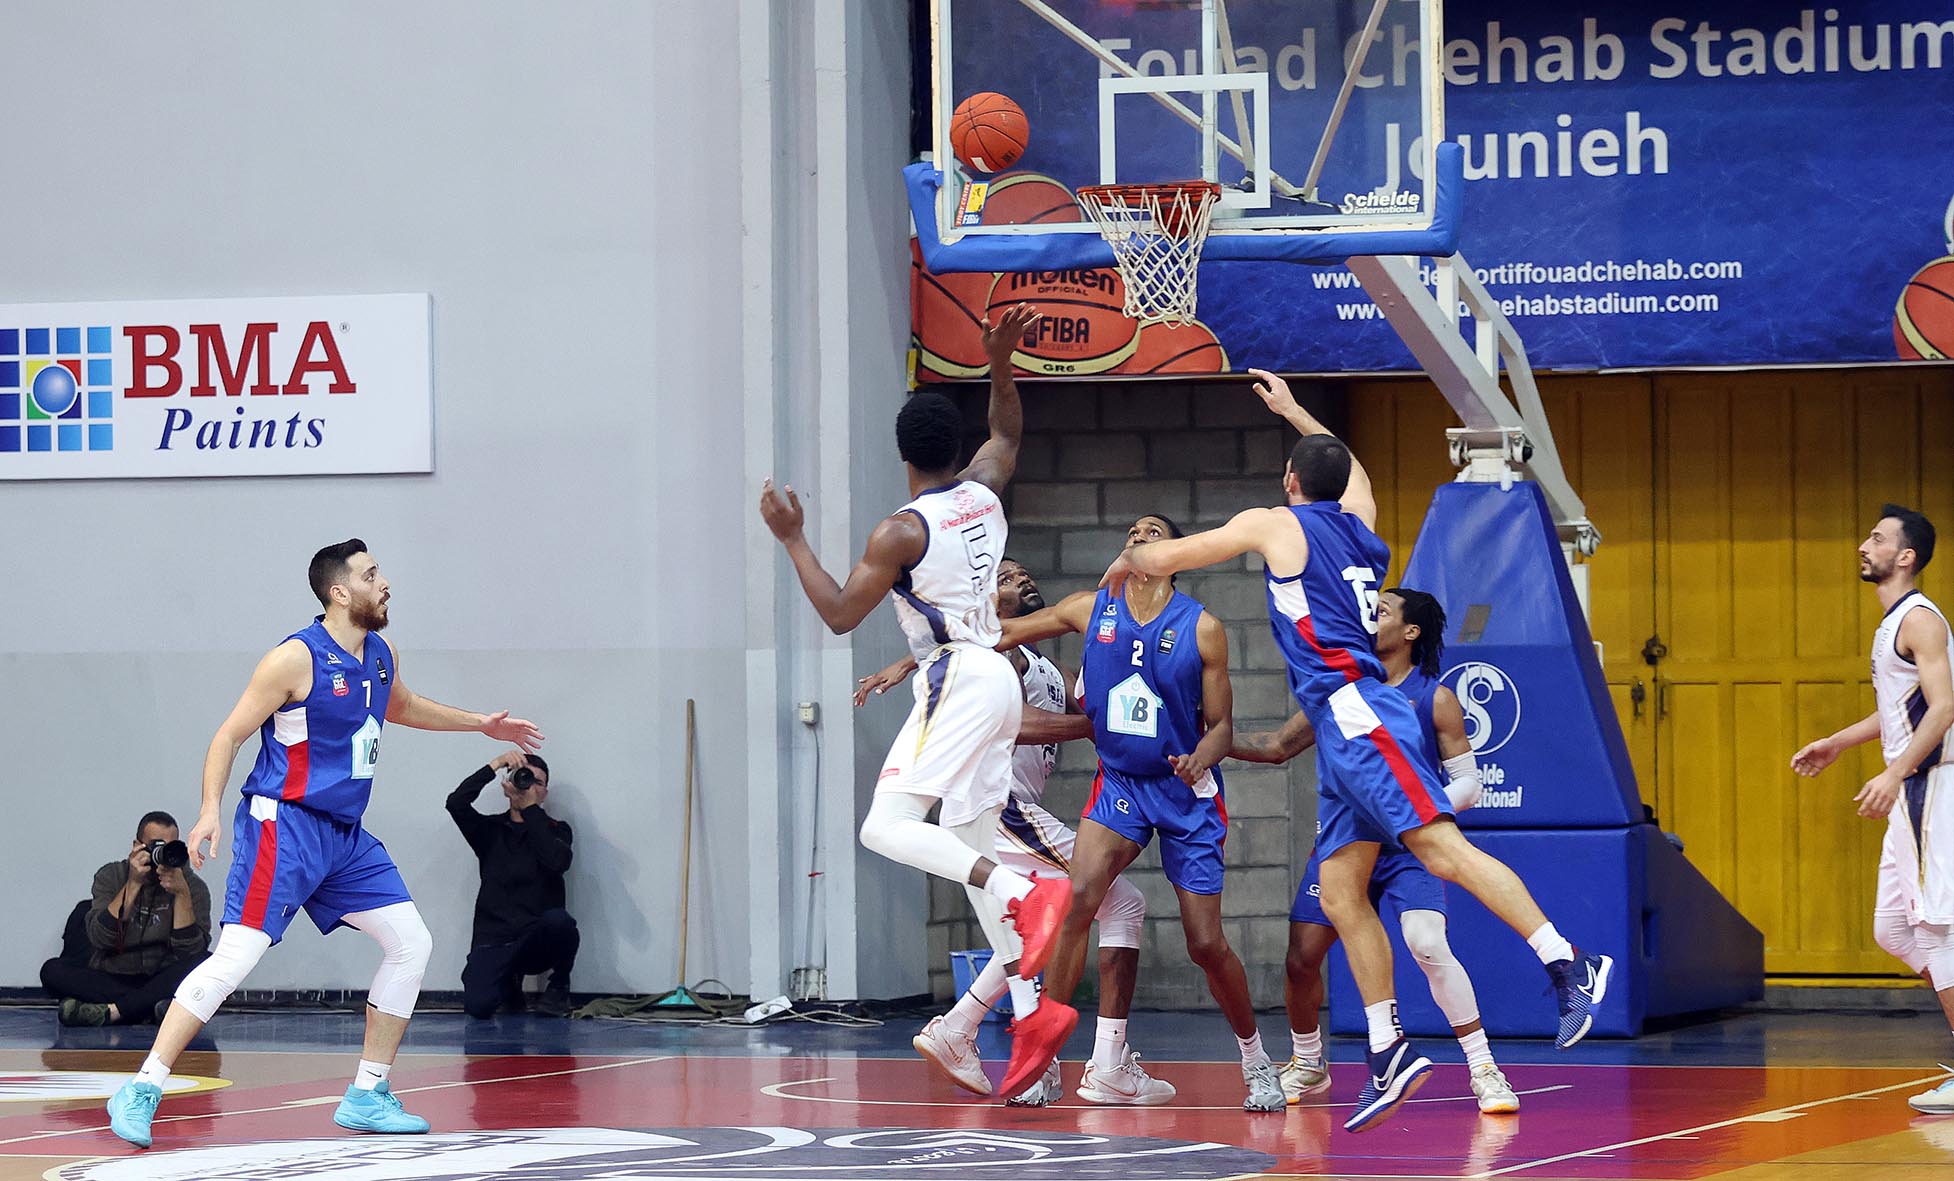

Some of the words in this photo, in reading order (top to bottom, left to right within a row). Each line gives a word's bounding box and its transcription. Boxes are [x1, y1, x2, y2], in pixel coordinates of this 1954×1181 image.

[1345, 18, 1625, 89] Chehab
[1649, 9, 1954, 79] Stadium
[1341, 190, 1420, 214] Schelde
[1037, 286, 1089, 297] OFFICIAL
[1038, 316, 1090, 344] FIBA
[123, 321, 357, 398] BMA
[155, 405, 326, 451] Paints
[1131, 639, 1145, 668] 2
[361, 679, 373, 709] 7
[1119, 694, 1149, 723] YB
[362, 738, 379, 766] YB
[1476, 763, 1505, 785] elde
